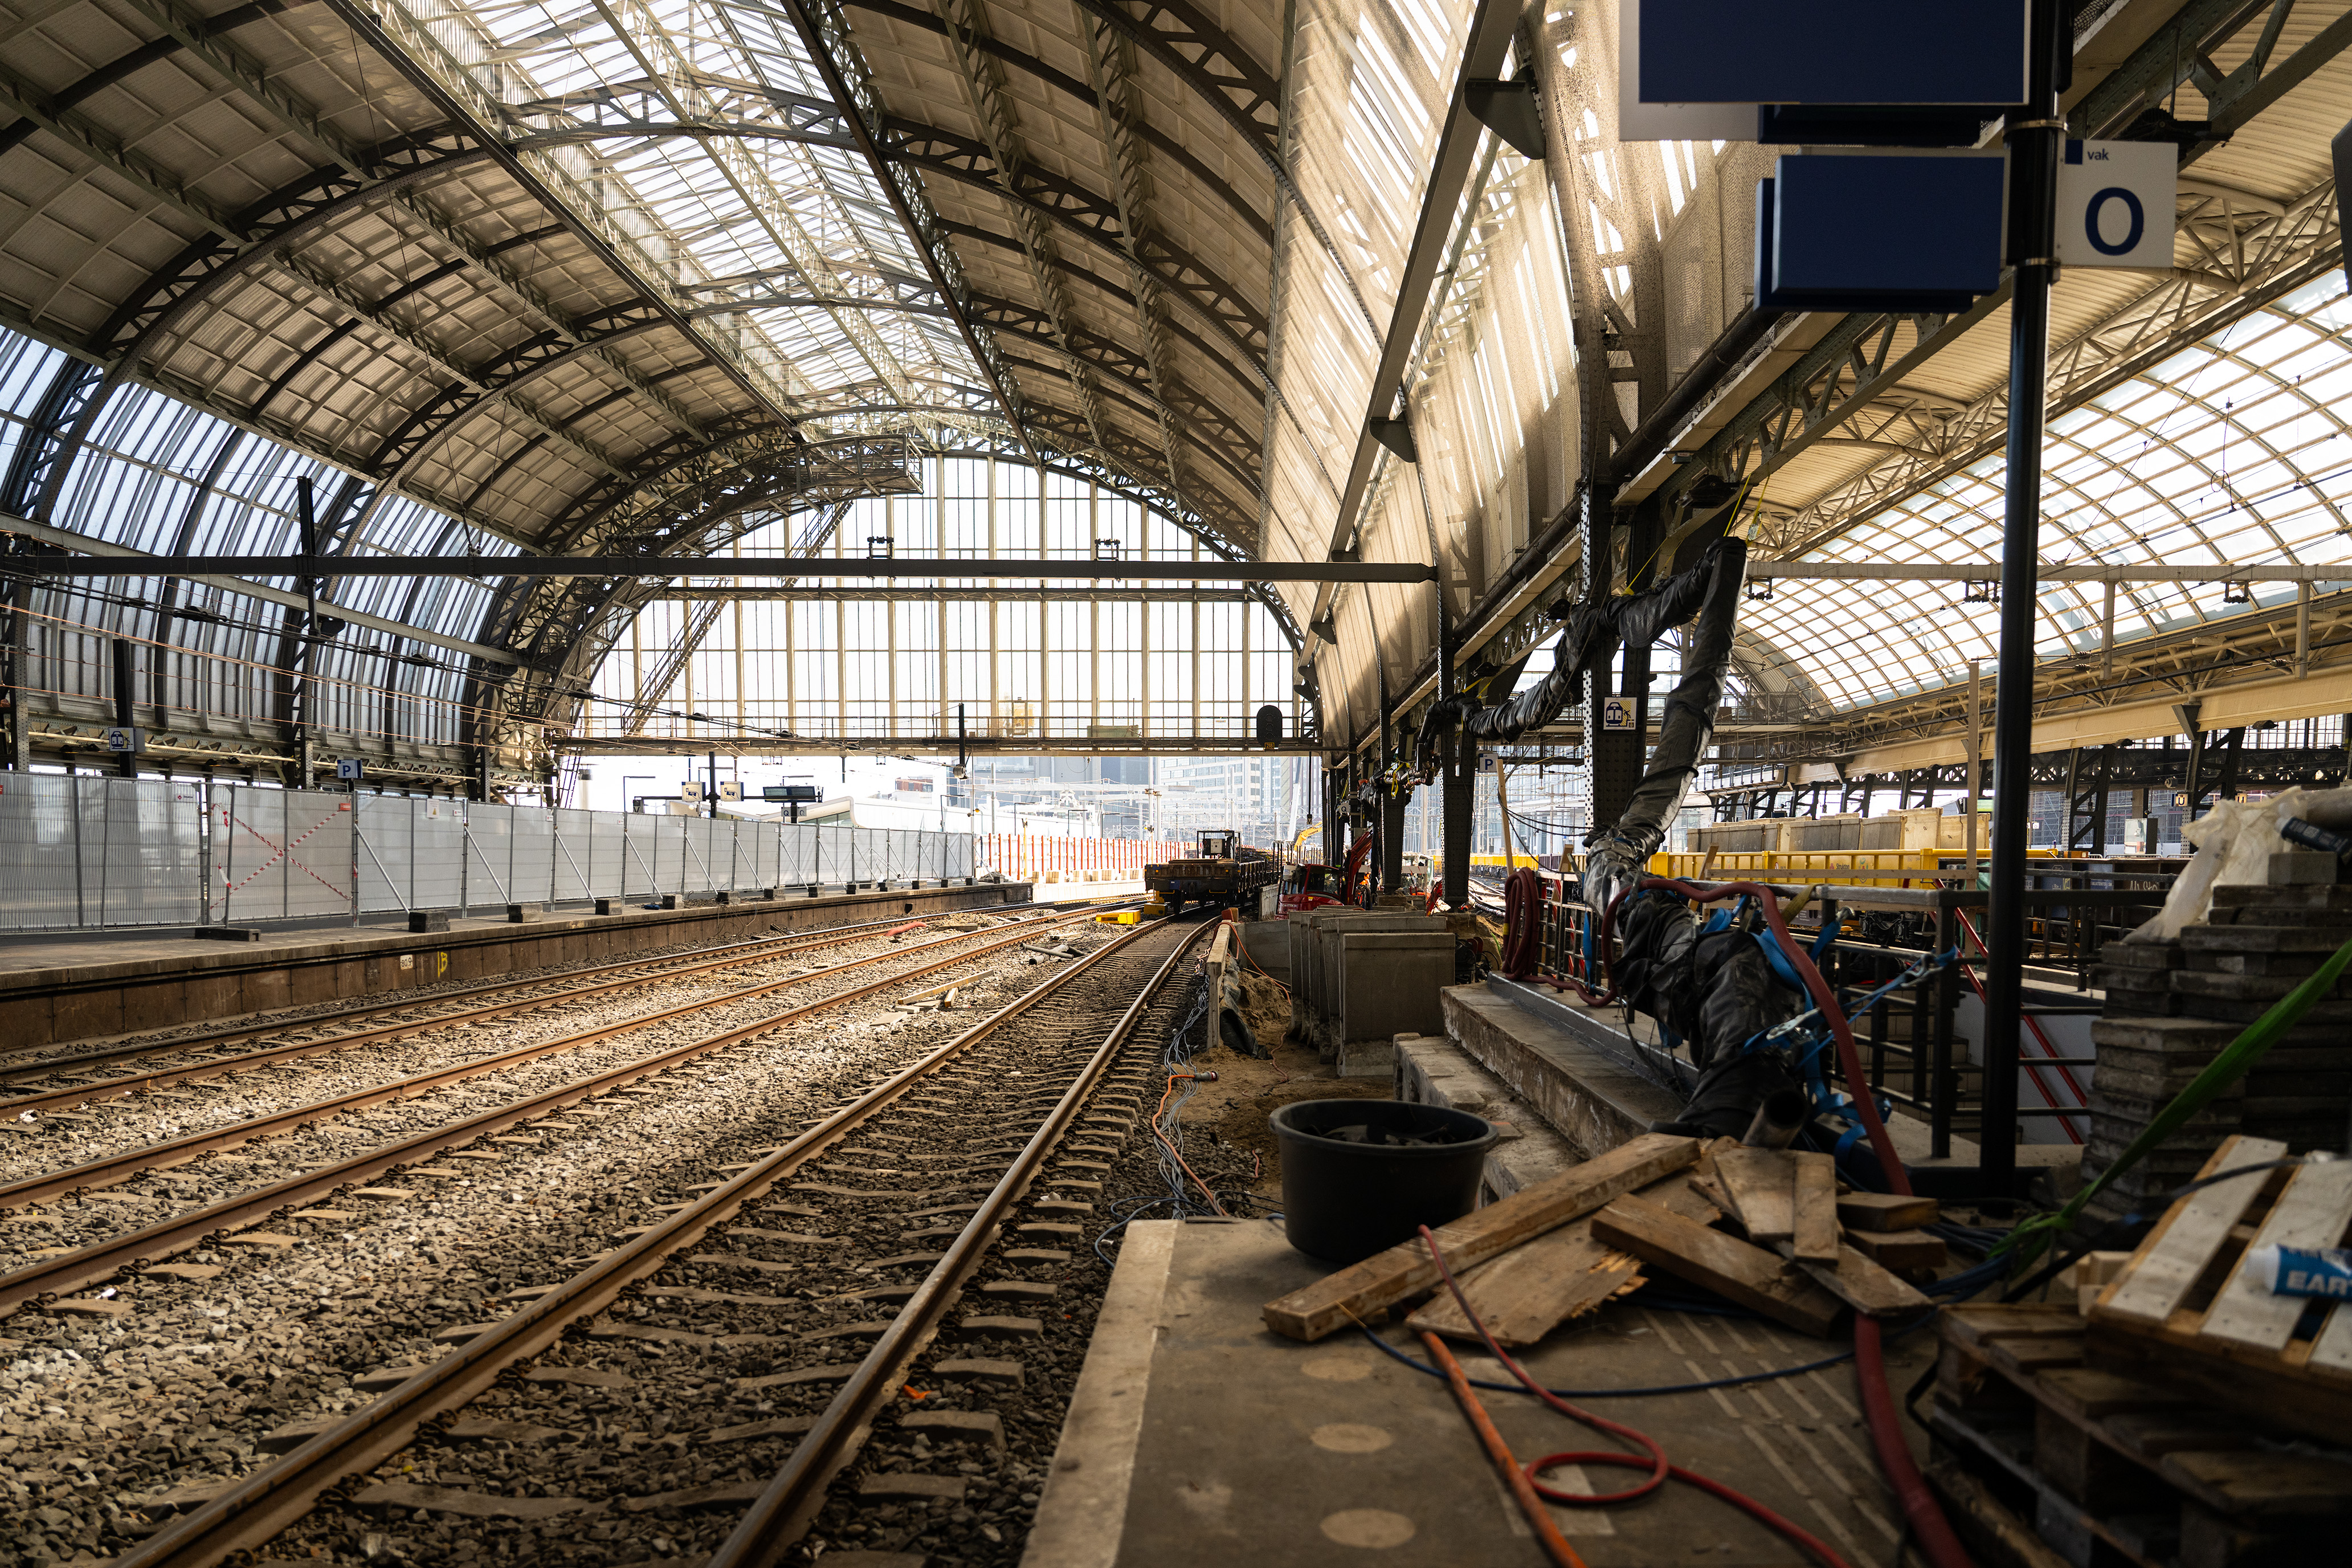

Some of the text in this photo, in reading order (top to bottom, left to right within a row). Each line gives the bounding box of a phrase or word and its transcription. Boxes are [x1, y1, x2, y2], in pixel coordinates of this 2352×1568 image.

[2087, 148, 2109, 161] vak
[2084, 187, 2144, 256] O
[1485, 758, 1493, 770] P
[342, 765, 351, 777] P
[2178, 797, 2185, 806] U
